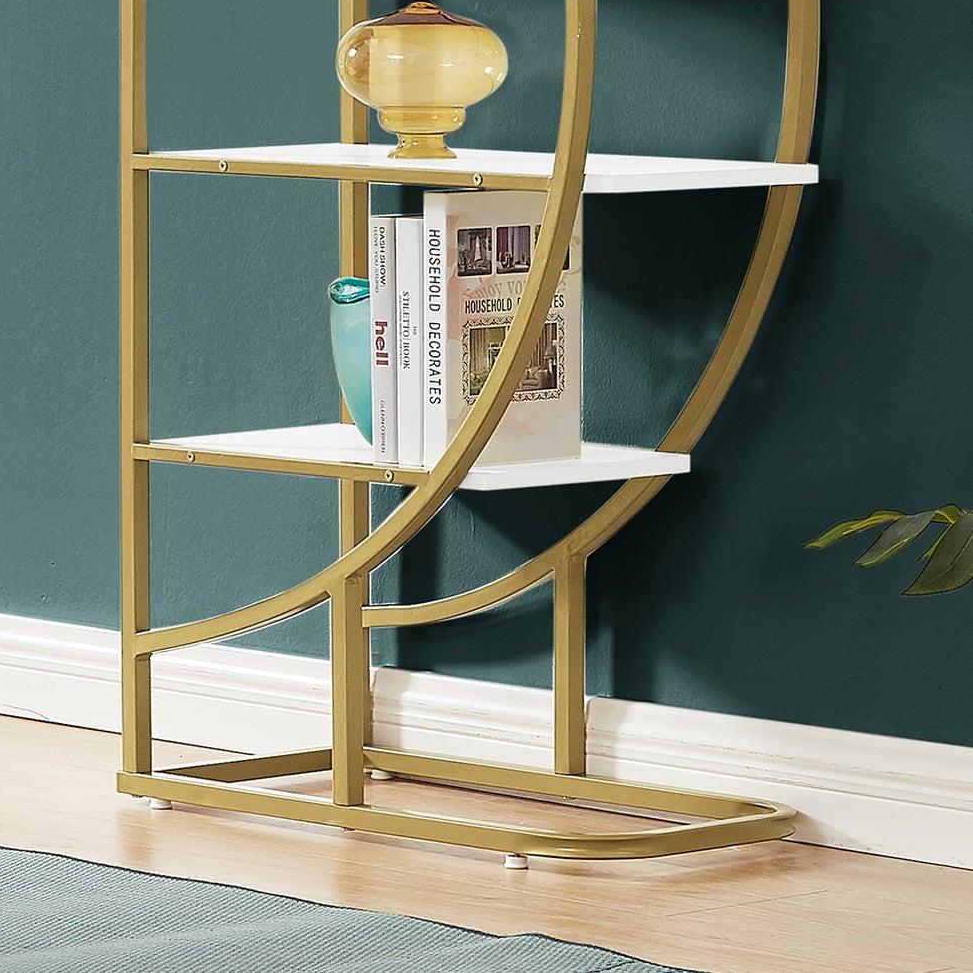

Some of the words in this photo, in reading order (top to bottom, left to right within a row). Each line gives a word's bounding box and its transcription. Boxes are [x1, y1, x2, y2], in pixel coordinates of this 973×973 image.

[428, 229, 441, 312] HOUSEHOLD
[402, 291, 411, 338] STILETTO
[464, 297, 513, 314] HOUSEHOLD
[375, 321, 389, 366] hell
[403, 342, 411, 370] BOOK
[428, 322, 442, 405] DECORATES
